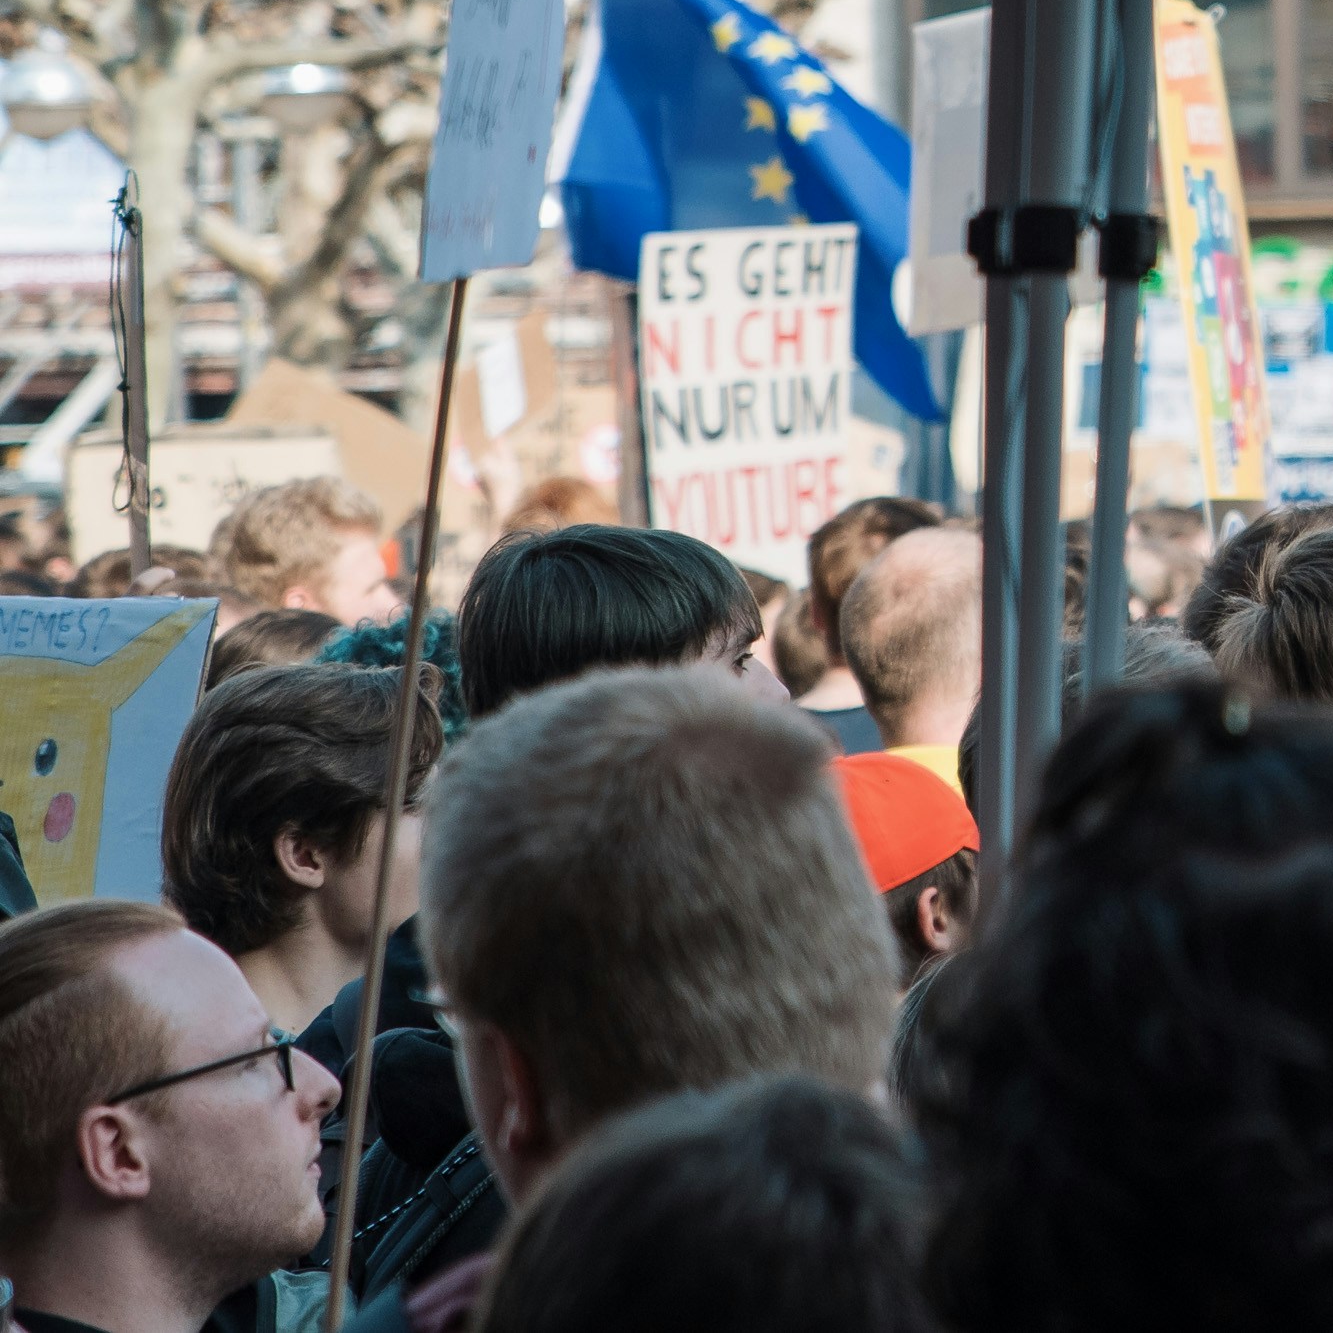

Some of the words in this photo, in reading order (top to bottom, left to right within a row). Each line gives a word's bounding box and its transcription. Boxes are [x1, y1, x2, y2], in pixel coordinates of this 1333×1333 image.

[657, 240, 709, 305] ES
[737, 236, 858, 299] GEHT
[643, 304, 846, 377] NICHT
[651, 377, 759, 452] NUR
[769, 369, 840, 438] UM
[652, 454, 847, 548] YOUTUBE
